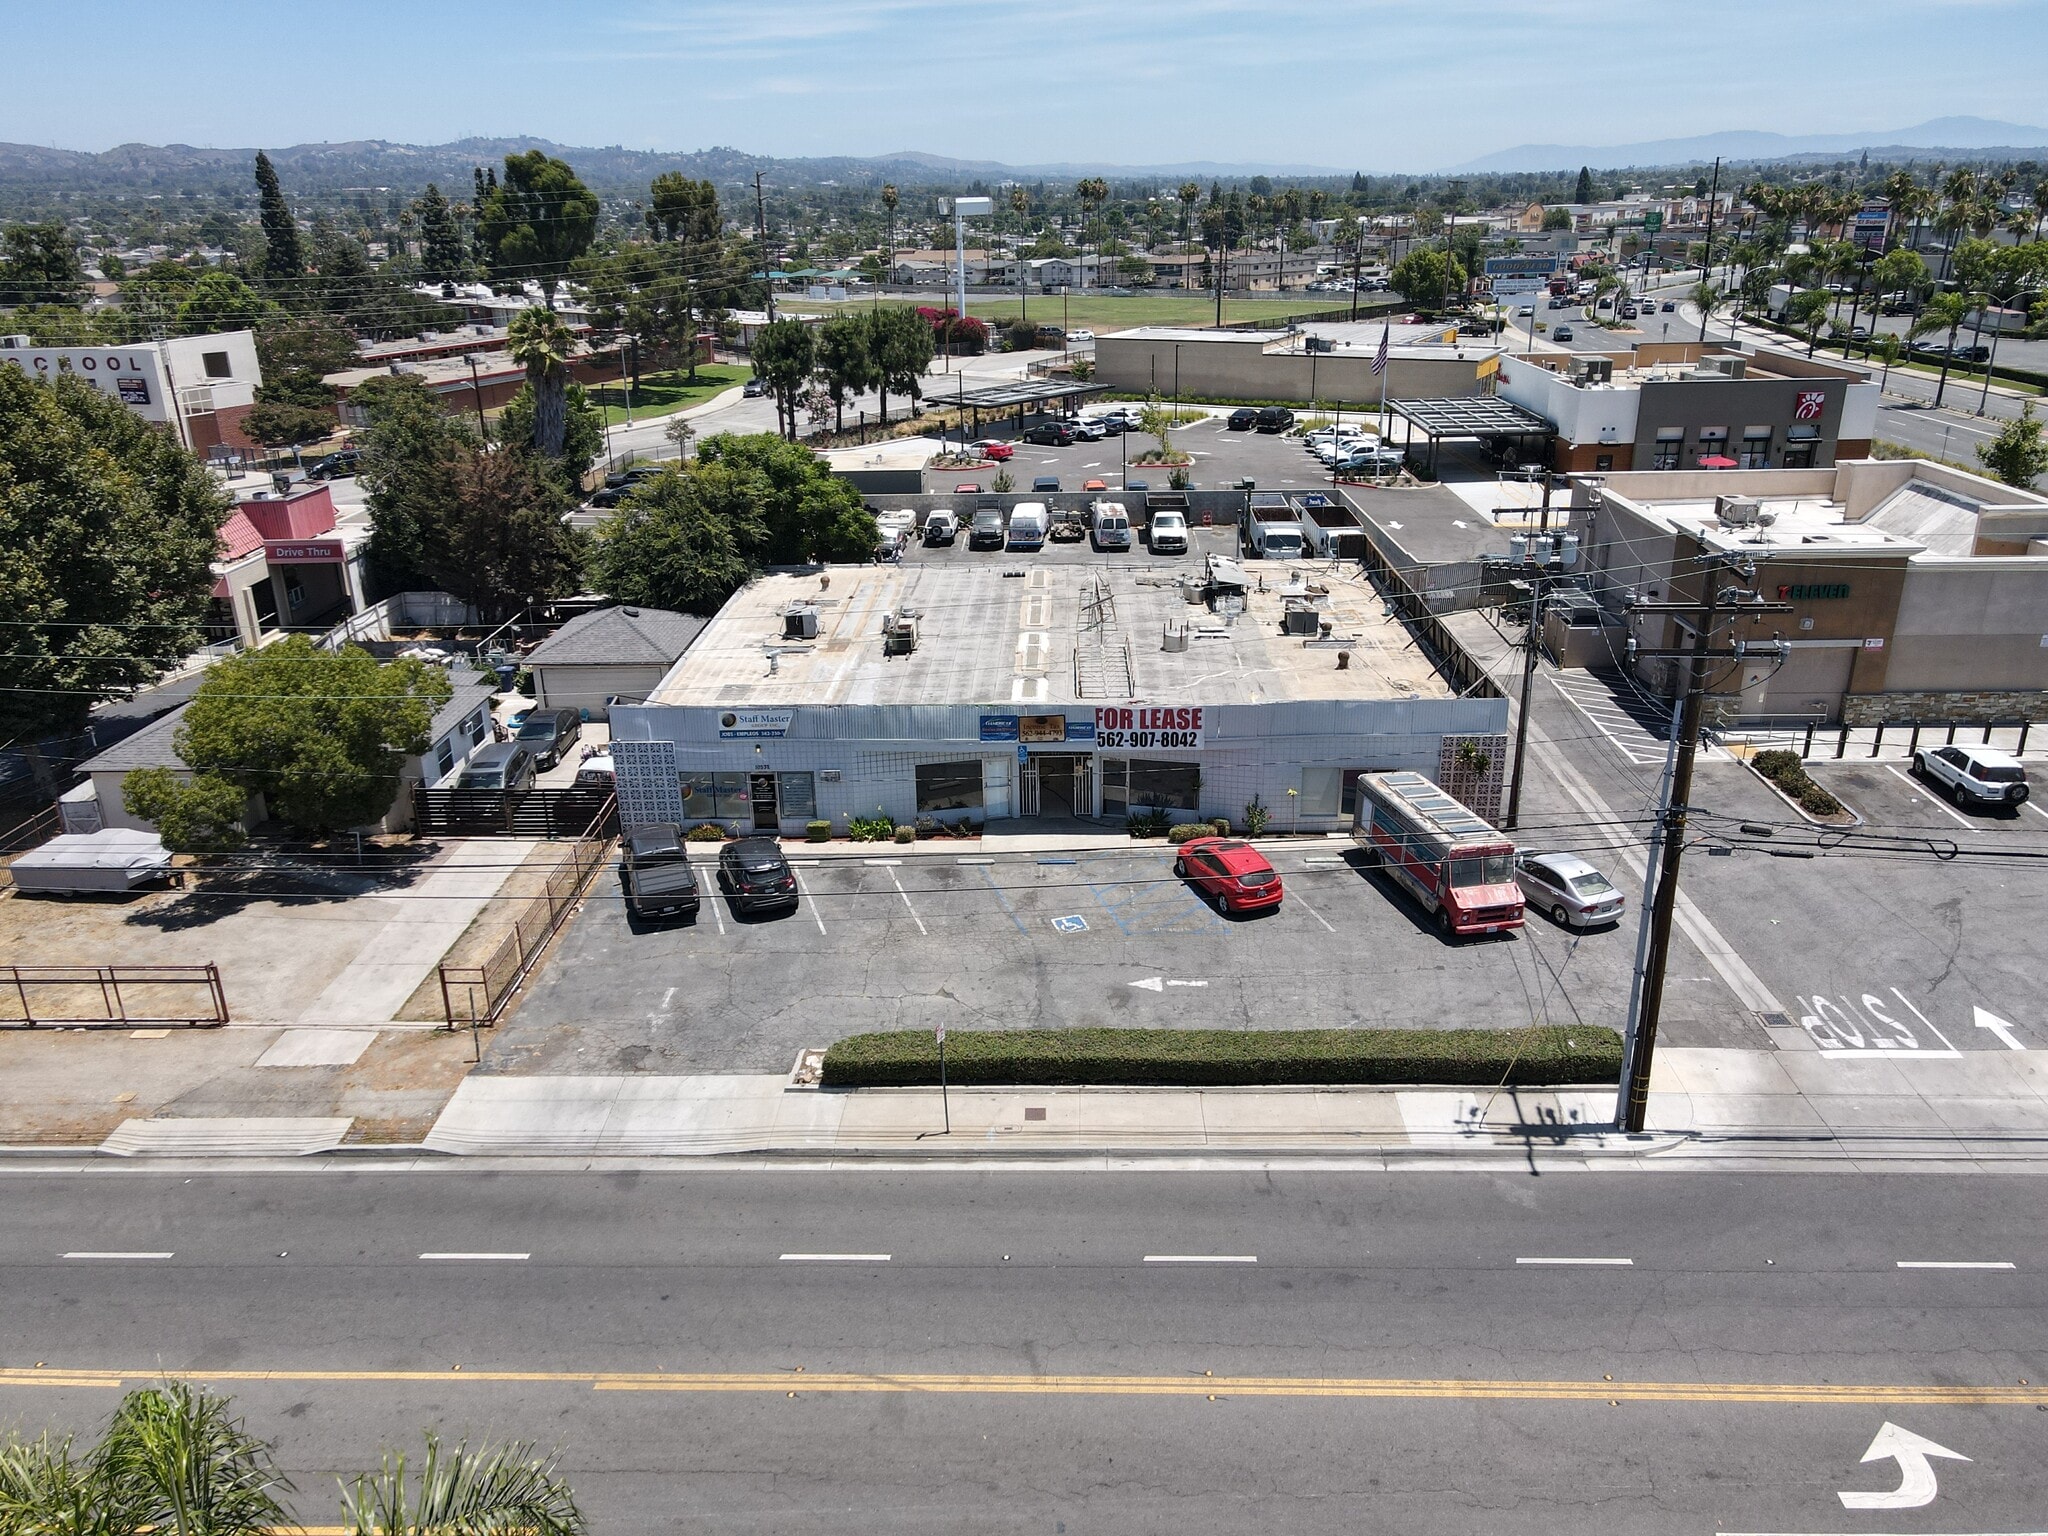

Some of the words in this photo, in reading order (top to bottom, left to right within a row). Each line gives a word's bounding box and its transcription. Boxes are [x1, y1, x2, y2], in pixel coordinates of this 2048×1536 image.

[276, 548, 304, 557] Drive
[306, 547, 331, 556] Thru
[739, 715, 760, 723] Staff
[761, 715, 790, 723] Master
[1096, 708, 1133, 730] FOR
[1140, 708, 1203, 730] LEASE
[1097, 731, 1197, 748] 562-907-8042
[1796, 993, 1919, 1049] STOP
